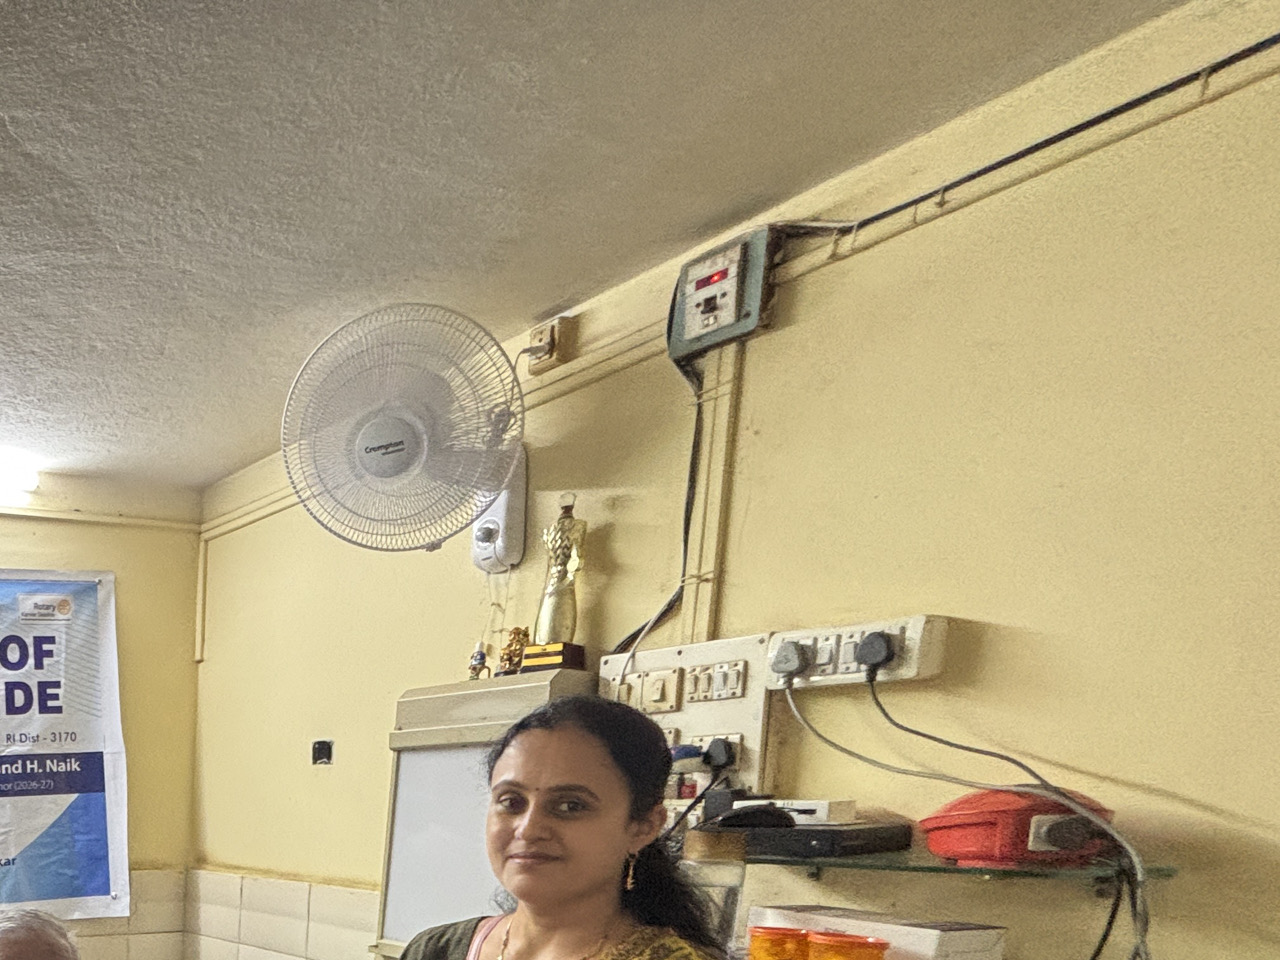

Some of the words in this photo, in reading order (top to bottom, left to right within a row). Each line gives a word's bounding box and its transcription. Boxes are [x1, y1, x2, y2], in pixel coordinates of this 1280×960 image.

[33, 602, 56, 612] Rotary
[6, 733, 16, 744] RI
[19, 732, 40, 744] Dist
[50, 731, 77, 743] 3170
[26, 760, 42, 774] H.
[46, 758, 81, 772] Naik
